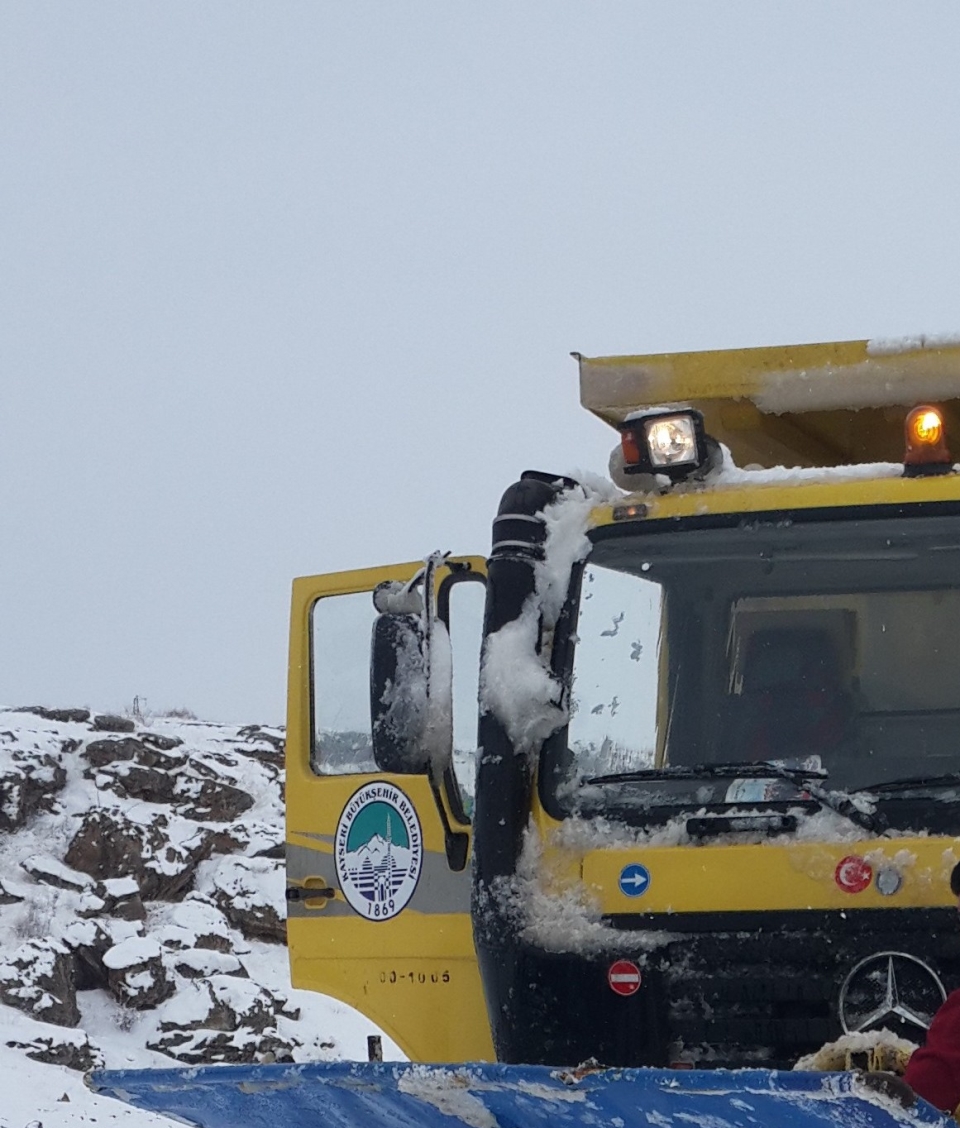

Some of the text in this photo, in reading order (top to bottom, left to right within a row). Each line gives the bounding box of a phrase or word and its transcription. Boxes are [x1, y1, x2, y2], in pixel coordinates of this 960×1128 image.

[338, 787, 420, 882] KAYSERİ BÜYÜKŞEHİR BELEDİYESİ
[368, 899, 395, 917] 1869
